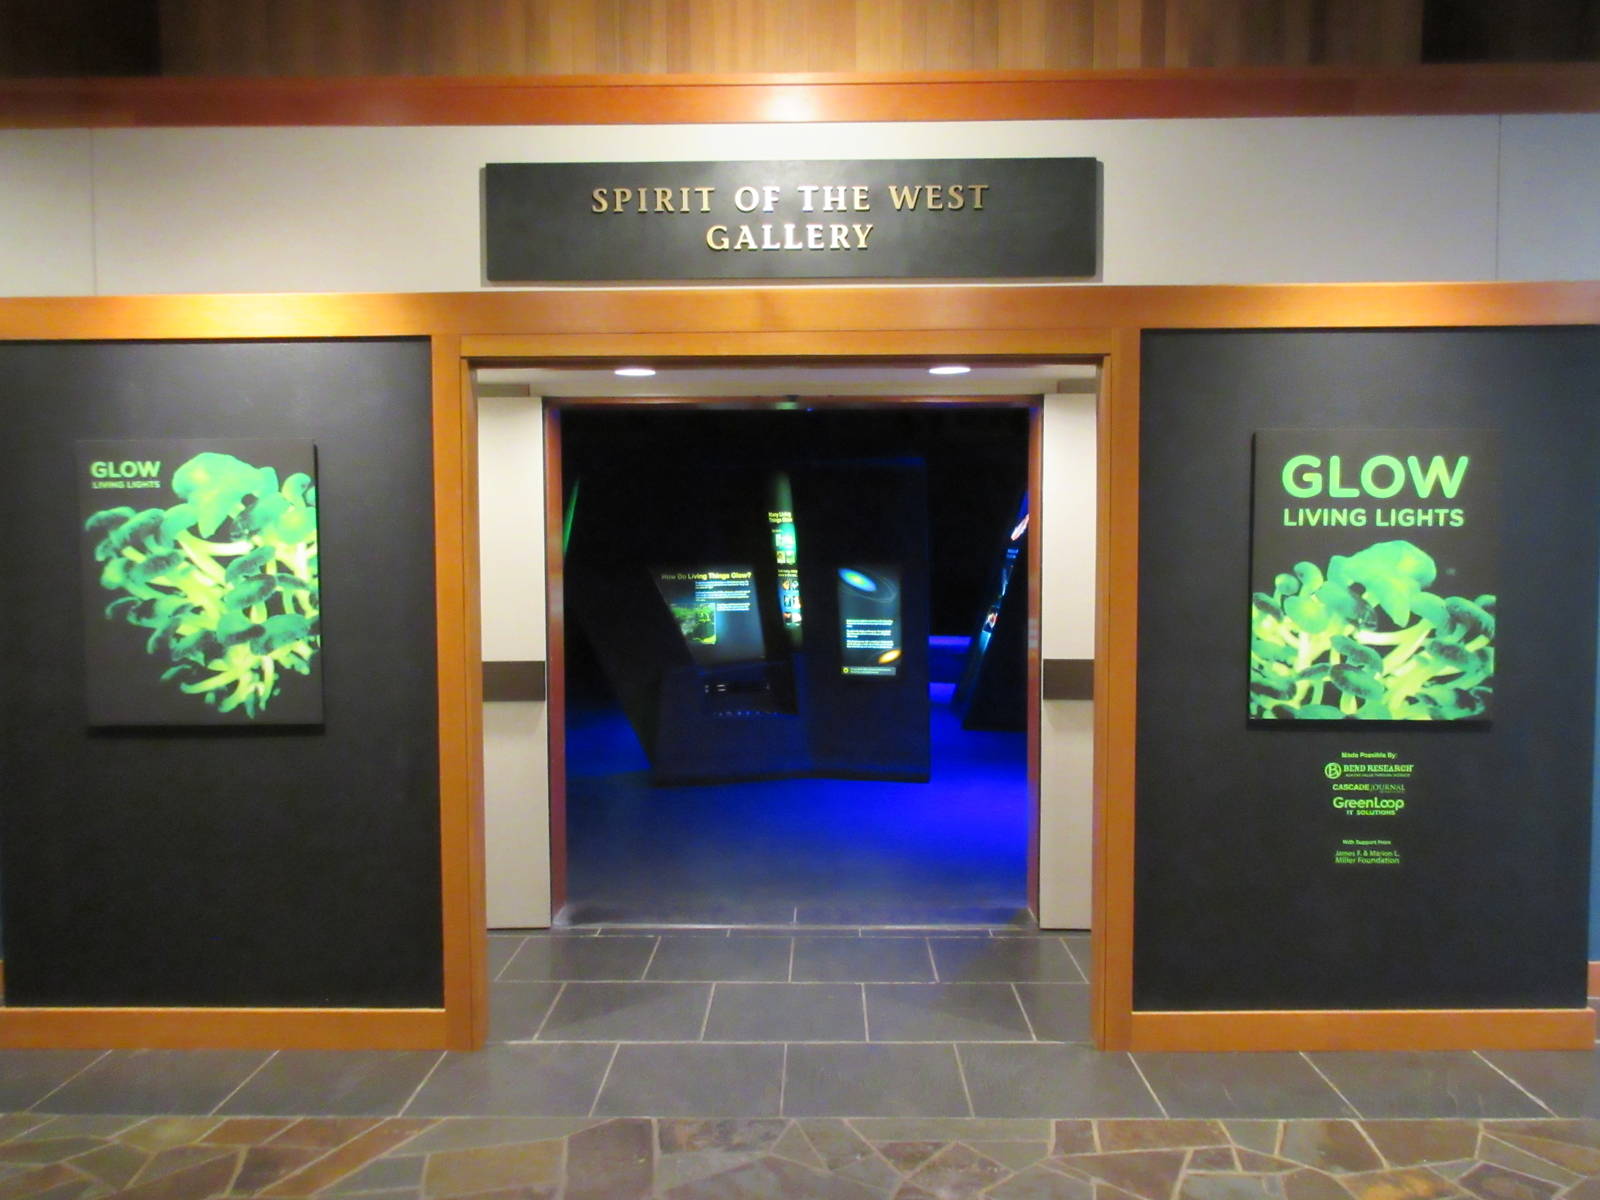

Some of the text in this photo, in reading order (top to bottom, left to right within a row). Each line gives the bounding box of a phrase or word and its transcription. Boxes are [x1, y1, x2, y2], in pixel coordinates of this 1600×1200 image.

[591, 184, 989, 213] SPIRIT OF THE WEST
[706, 224, 875, 250] GALLERY
[91, 461, 161, 478] GLOW
[1281, 454, 1469, 499] GLOW
[1283, 508, 1465, 527] LIVING LIGHTS
[687, 572, 708, 581] Living
[708, 572, 730, 580] Things
[1343, 764, 1413, 773] BEND RESEARCH
[1332, 796, 1405, 810] GreenLoop
